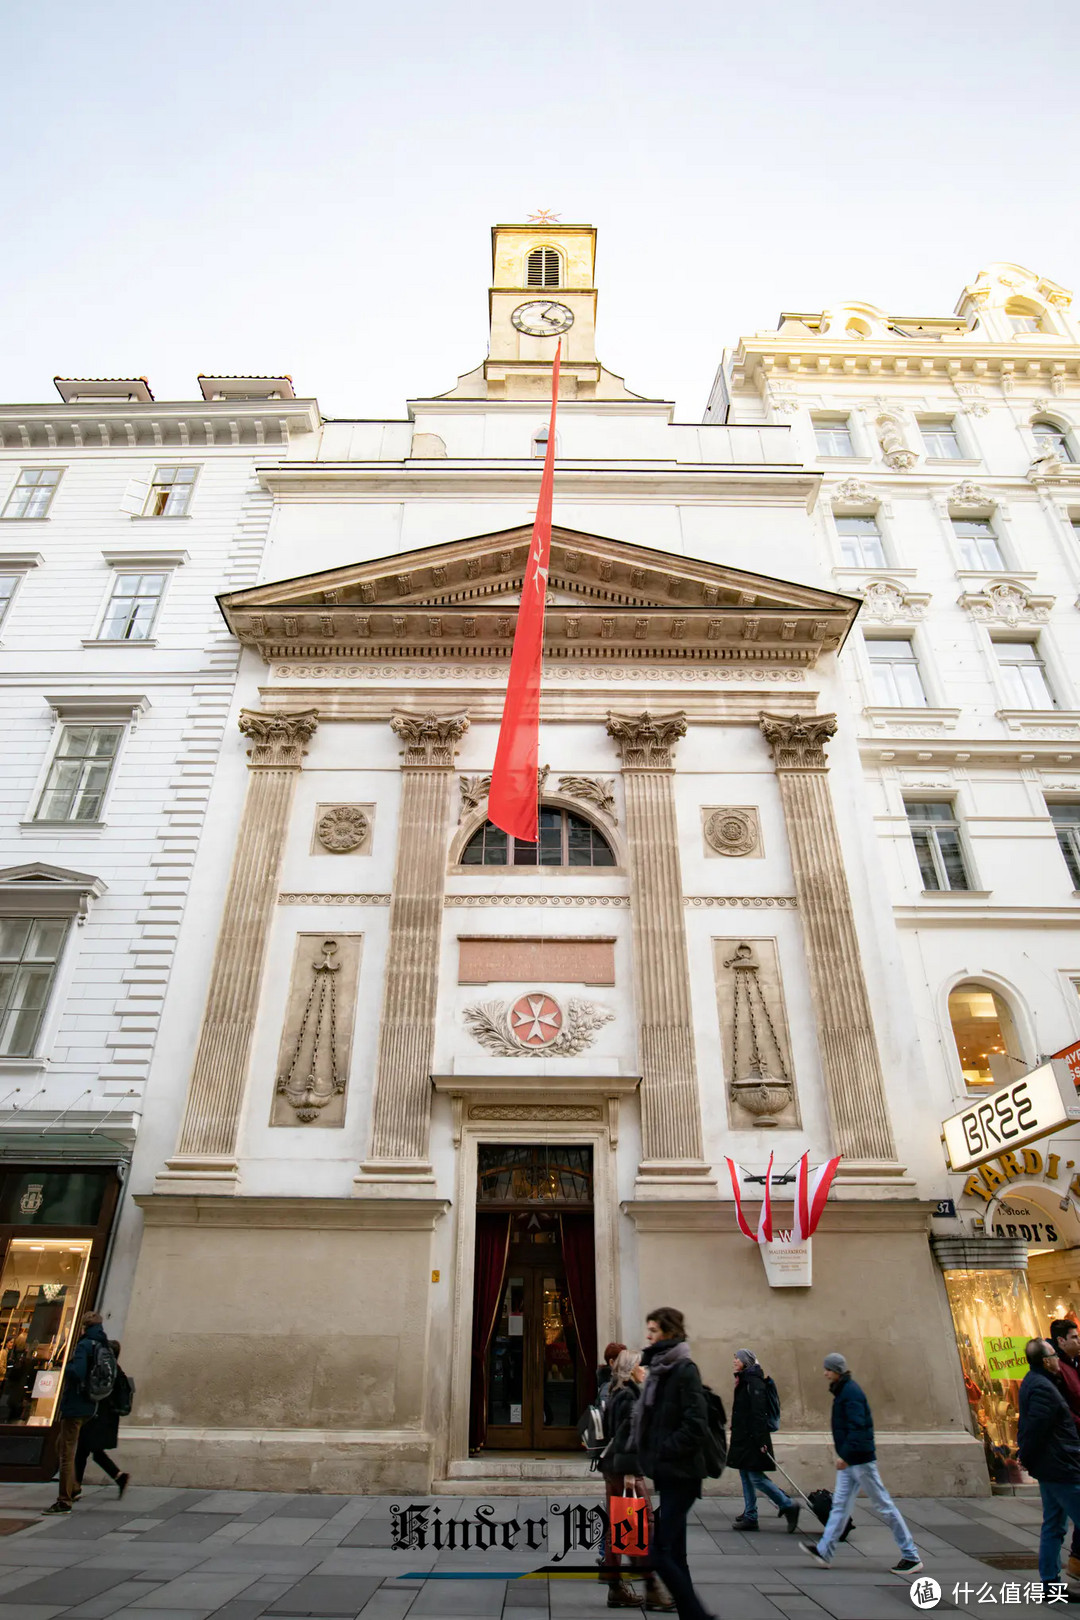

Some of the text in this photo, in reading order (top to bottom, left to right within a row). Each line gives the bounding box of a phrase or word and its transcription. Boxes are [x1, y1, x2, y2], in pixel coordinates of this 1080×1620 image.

[962, 1082, 1038, 1156] BREE
[937, 1201, 950, 1213] 37
[991, 1222, 1058, 1242] ARDI'S
[989, 1351, 1029, 1371] Abverka
